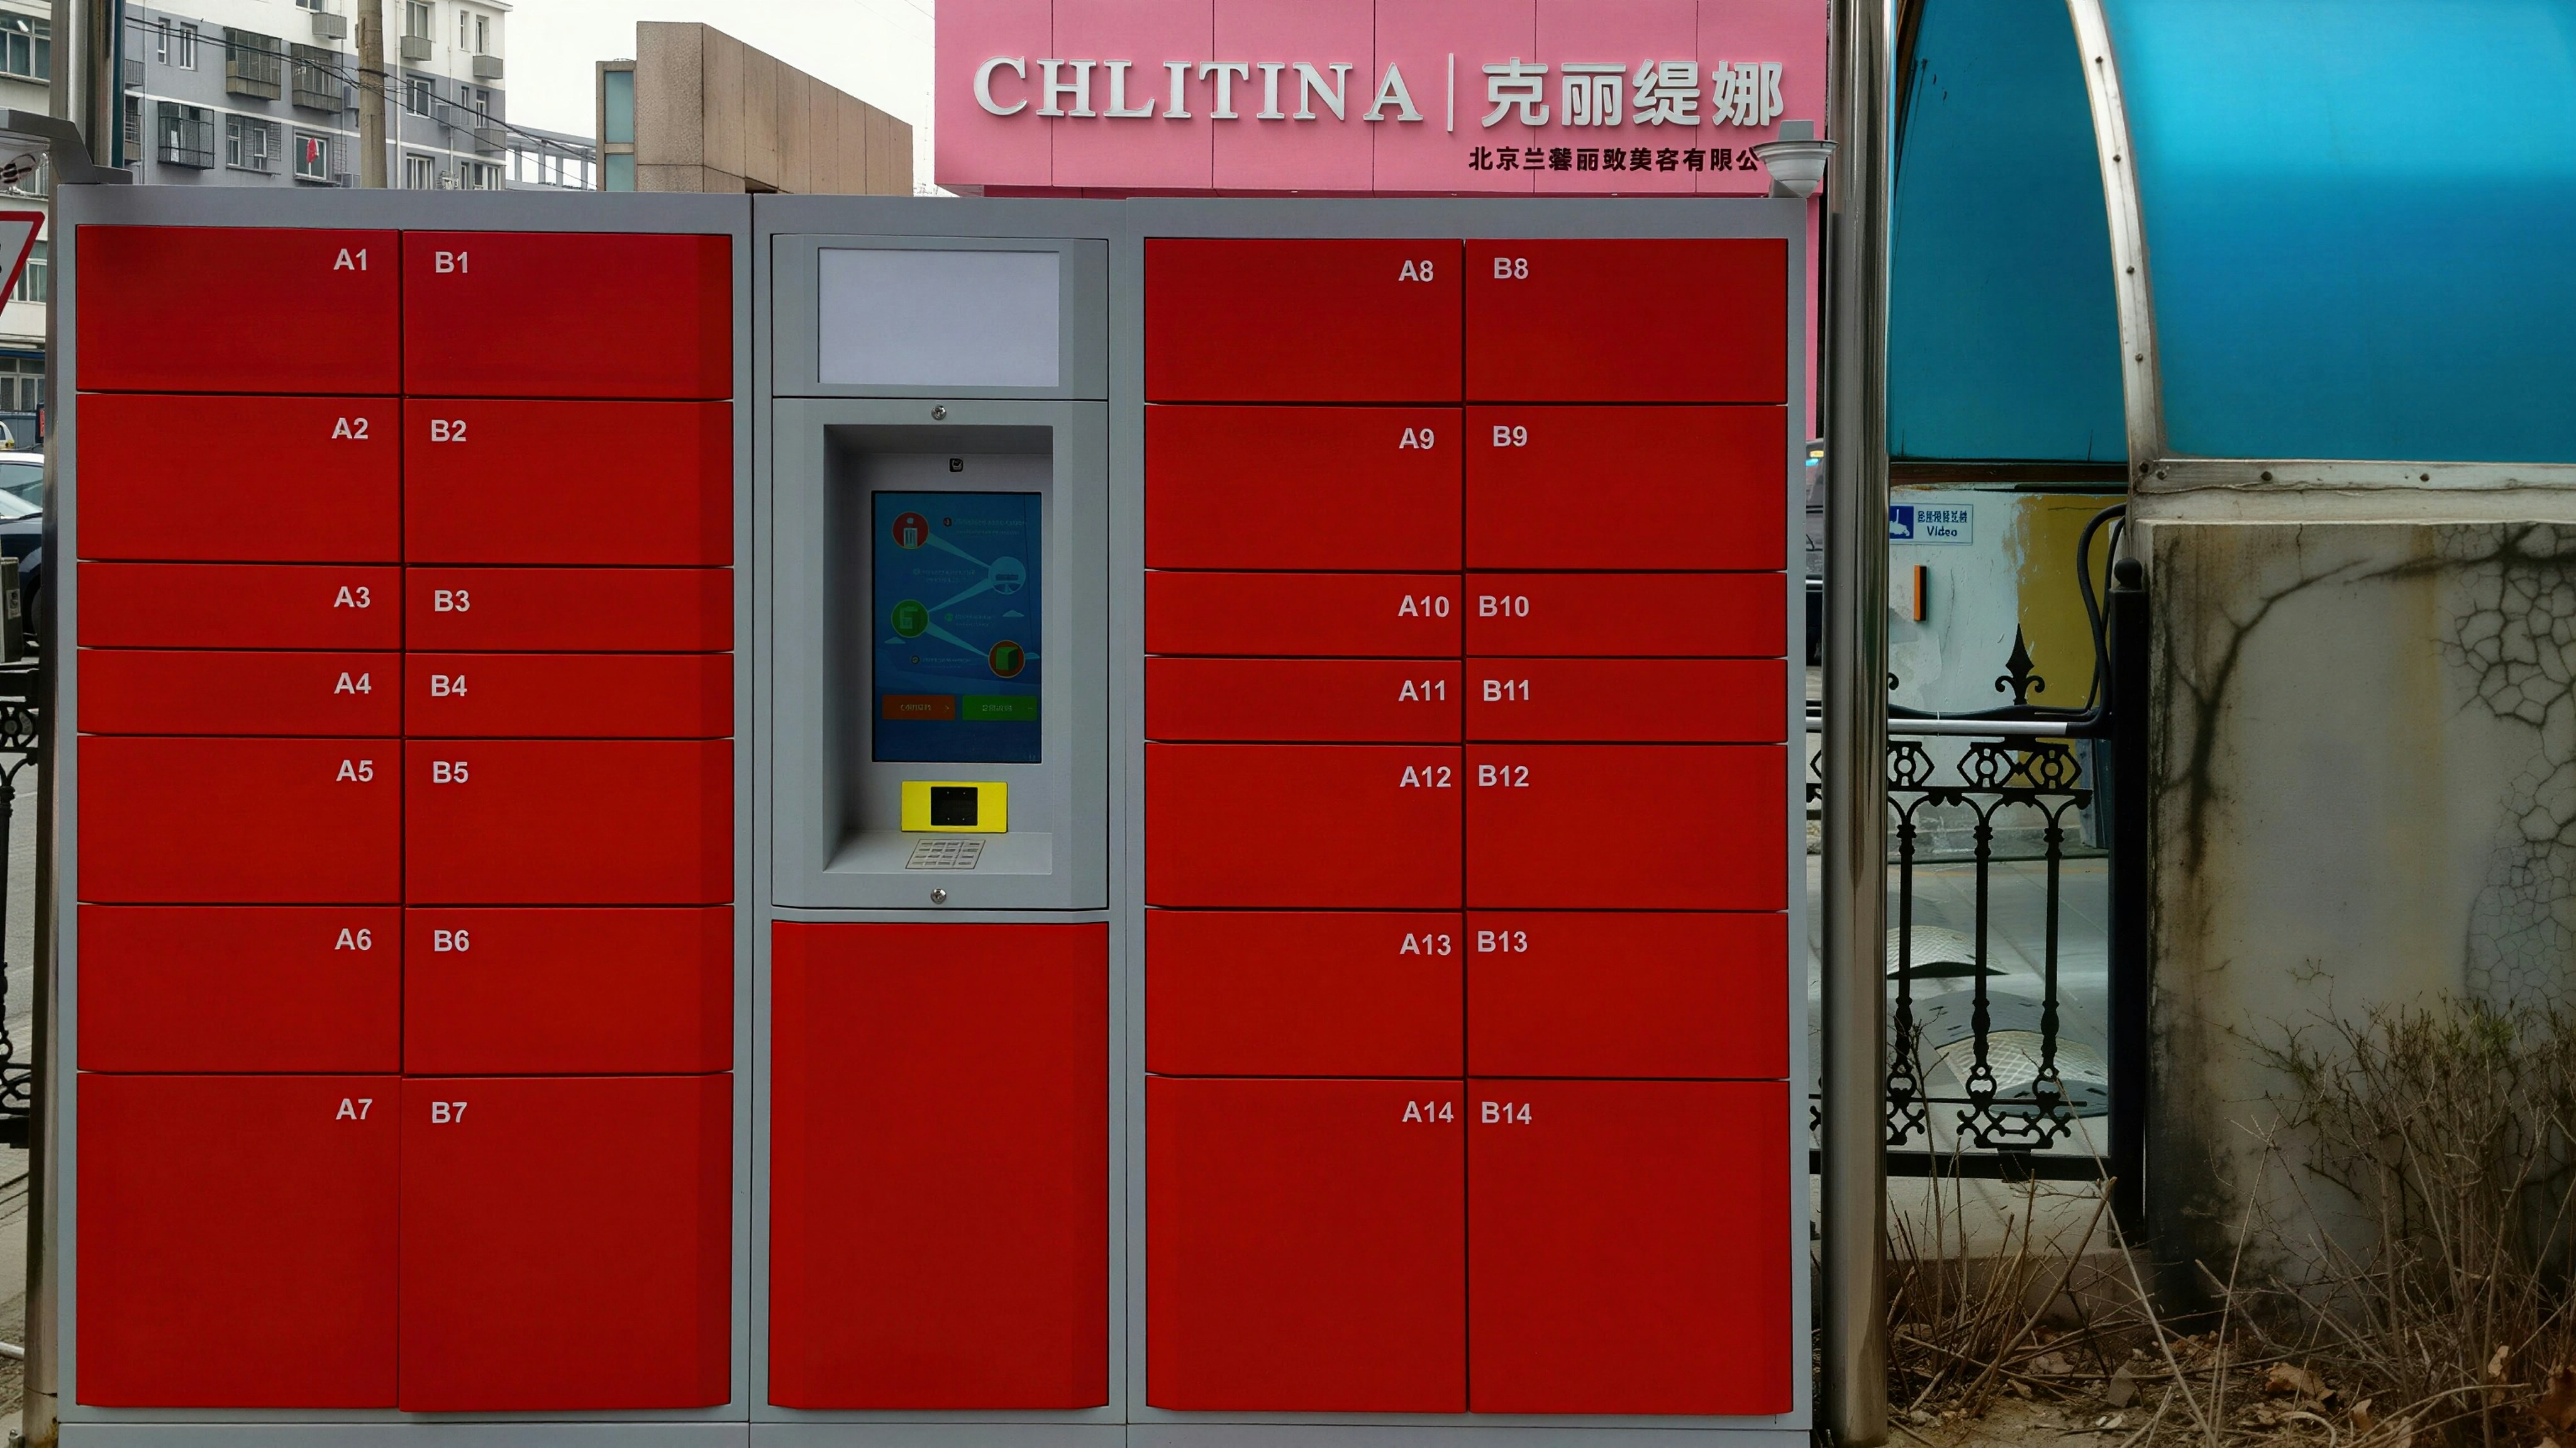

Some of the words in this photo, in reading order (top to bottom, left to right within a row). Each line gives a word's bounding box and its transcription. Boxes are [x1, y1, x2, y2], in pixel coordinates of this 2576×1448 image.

[974, 55, 1423, 121] CHLITINA
[1481, 57, 1784, 126] 克丽缇娜
[333, 248, 367, 270] A1
[435, 251, 468, 274] B1
[1494, 257, 1529, 279] B8
[1398, 260, 1434, 282] A8
[331, 417, 369, 440] A2
[431, 419, 467, 442] B2
[1399, 427, 1435, 450] A9
[1493, 425, 1528, 447] B9
[333, 586, 370, 608] A3
[435, 589, 470, 612] B3
[1397, 594, 1450, 618] A10
[1479, 595, 1530, 617] B10
[333, 672, 372, 694] A4
[431, 674, 468, 697] B4
[1398, 679, 1445, 701] A11
[1483, 679, 1529, 701] B11
[336, 759, 374, 782] A5
[433, 760, 469, 784] B5
[1399, 766, 1452, 788] A12
[1479, 764, 1530, 787] B12
[334, 928, 372, 950] A6
[434, 929, 470, 952] B6
[1399, 933, 1452, 956] A13
[1477, 930, 1528, 952] B13
[335, 1098, 373, 1120] A7
[431, 1101, 468, 1123] B7
[1402, 1101, 1454, 1123] A14
[1482, 1101, 1532, 1125] B14
